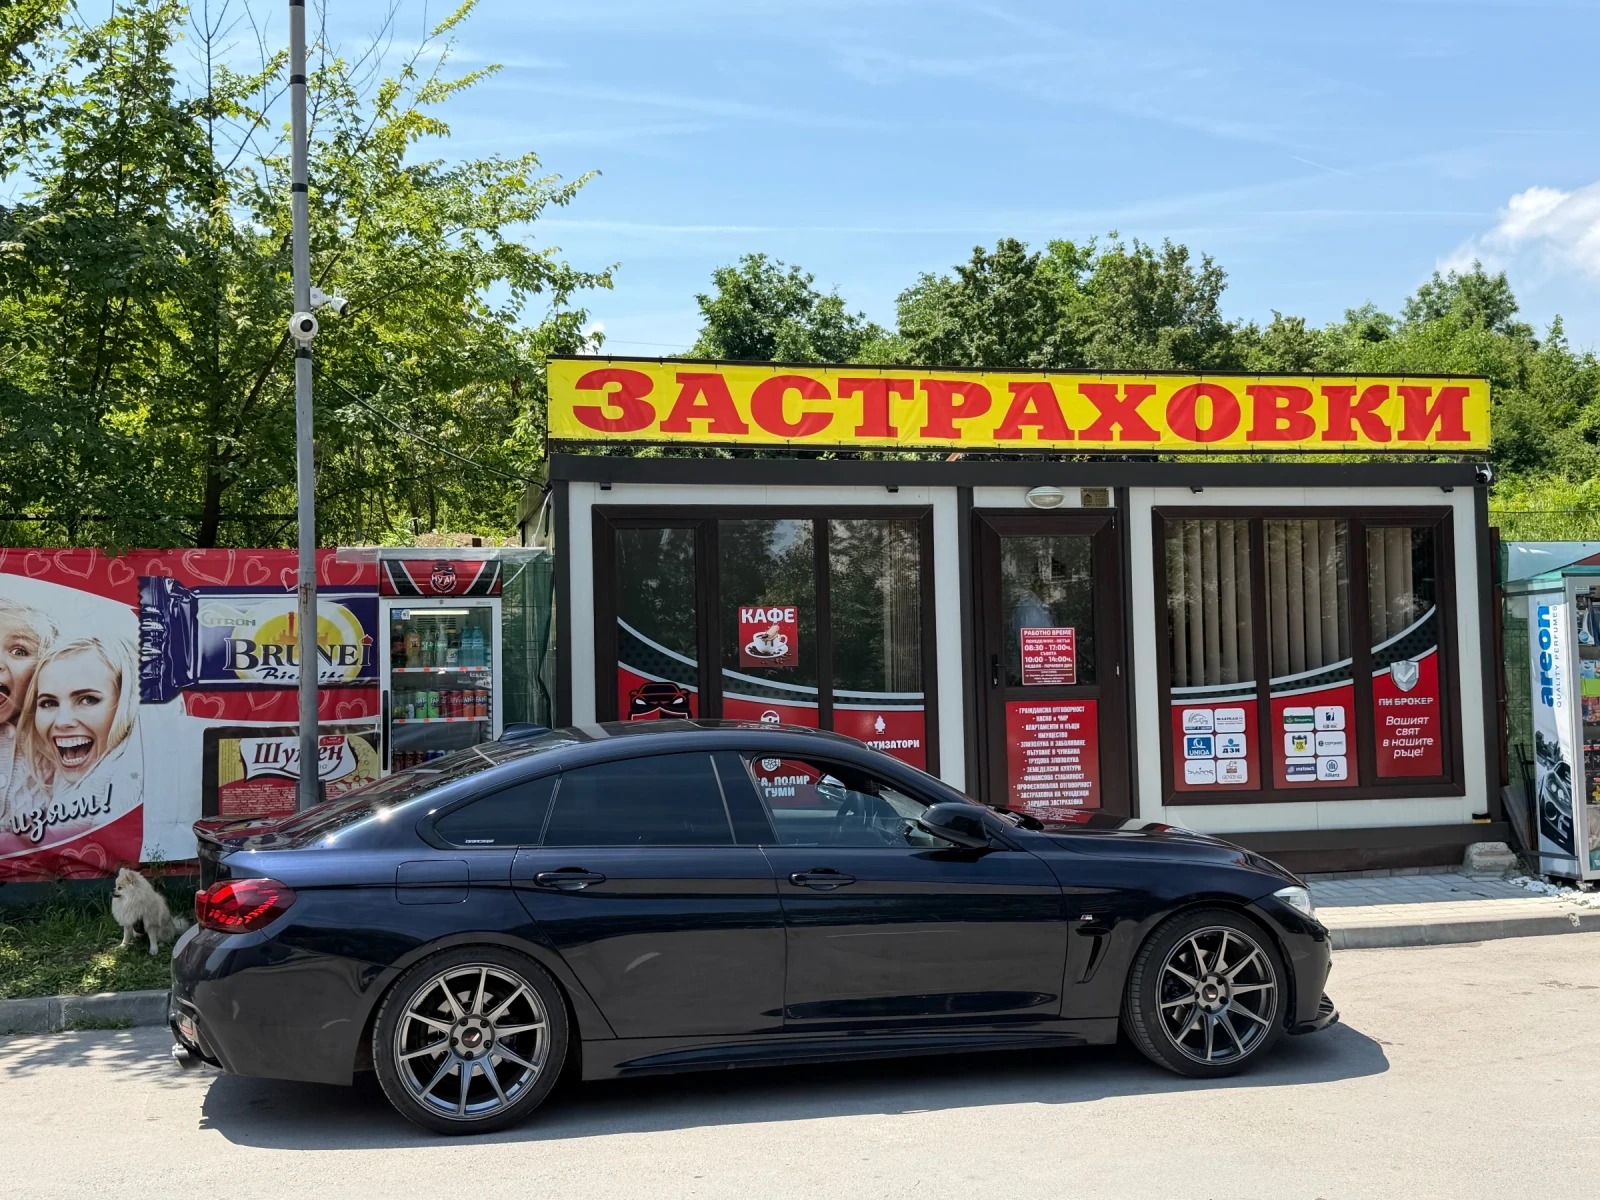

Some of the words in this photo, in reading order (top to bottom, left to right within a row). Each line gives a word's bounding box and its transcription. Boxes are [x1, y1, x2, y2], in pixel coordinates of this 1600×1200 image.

[573, 368, 1471, 442] ЗАСТРАХОВКИ
[741, 607, 795, 624] КАФЕ
[1552, 605, 1560, 660] PERFUMES
[1538, 606, 1554, 707] areon
[1378, 698, 1393, 706] ПИ
[1394, 697, 1434, 706] БРОКЕР
[1386, 715, 1430, 726] Вашият
[1395, 727, 1421, 736] свят
[1382, 739, 1390, 747] в
[1391, 737, 1434, 747] нашите
[252, 742, 343, 770] Шуен
[1393, 746, 1424, 759] ръце!
[774, 775, 810, 786] ПОЛИР
[765, 787, 795, 797] ГУМИ
